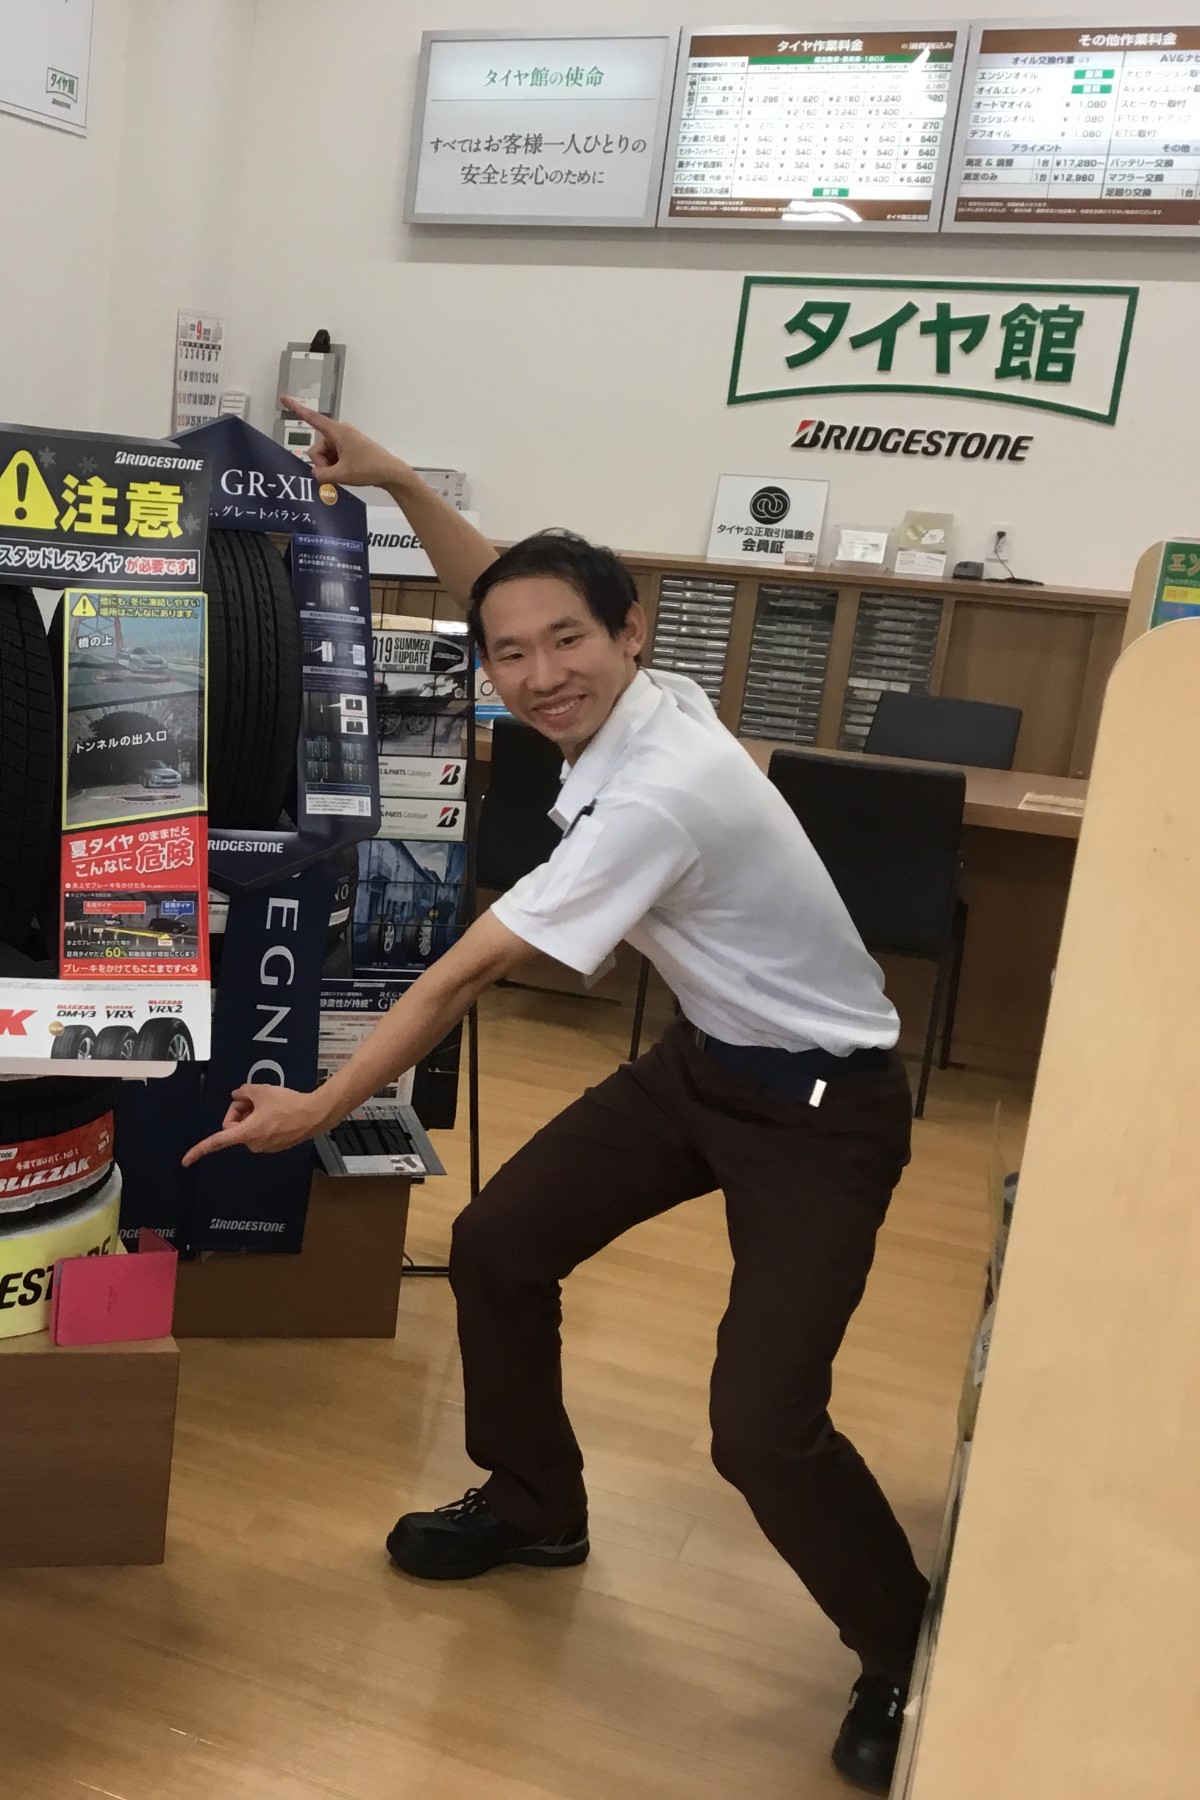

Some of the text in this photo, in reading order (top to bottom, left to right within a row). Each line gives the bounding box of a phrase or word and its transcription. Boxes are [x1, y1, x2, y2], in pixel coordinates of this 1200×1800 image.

[778, 40, 863, 52] タイヤ作業料金
[1079, 33, 1177, 46] その他作業料金
[1012, 56, 1074, 65] オイル交換作業
[484, 66, 604, 87] タイヤ館の使命
[979, 72, 1038, 80] エンジンオイル
[50, 74, 75, 95] タイヤ館
[977, 86, 1042, 94] オイルエレメント
[974, 101, 1032, 109] オートマオイル
[970, 130, 1012, 138] デフオイル
[430, 133, 647, 154] すべてはお客様一人ひとりの
[1162, 144, 1190, 152] その他
[1111, 159, 1173, 167] バッテリー交換
[461, 164, 605, 185] 安全と安心のために
[963, 173, 998, 181] 測定のみ
[1109, 174, 1164, 182] マフラー交換
[196, 320, 203, 340] 9
[784, 300, 1085, 383] タイヤ館
[791, 419, 1033, 462] BRIDGESTONE
[114, 450, 204, 471] BRIDGESTONE
[60, 473, 184, 538] 注意
[717, 524, 814, 541] タイヤ公正取引協議会
[742, 538, 784, 554] 会員証
[78, 635, 113, 648] 橋の上
[394, 637, 430, 651] SUMMER
[399, 652, 428, 664] UPDATE
[76, 731, 167, 753] トンネルの出入口
[64, 964, 198, 974] ブレーキをかけてもここまですべる
[57, 1010, 96, 1018] DM-V3
[106, 1010, 136, 1019] VRX
[148, 1005, 183, 1014] VRX2
[210, 1218, 286, 1233] BRIDGESTONE
